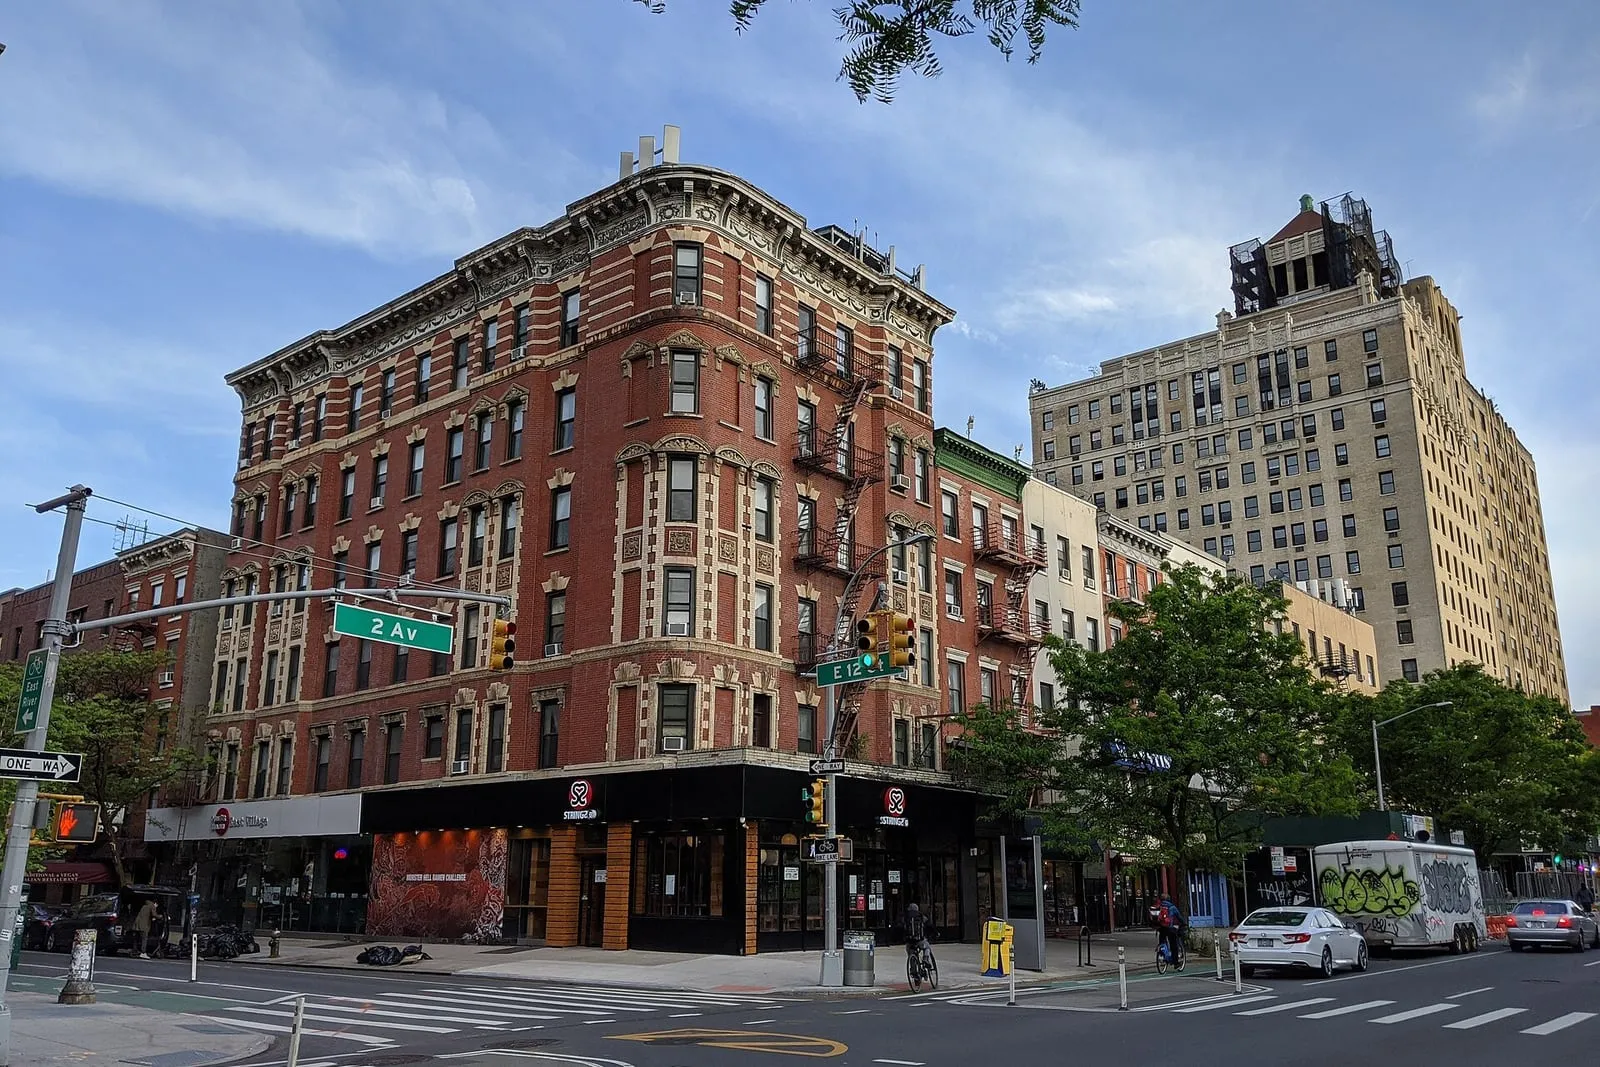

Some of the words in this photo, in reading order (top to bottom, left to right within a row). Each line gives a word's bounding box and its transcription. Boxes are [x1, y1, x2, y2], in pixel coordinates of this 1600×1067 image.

[371, 617, 384, 635] 2
[390, 622, 418, 641] Av
[833, 665, 843, 680] E
[846, 662, 862, 677] 12
[867, 659, 884, 673] t
[26, 680, 39, 692] East
[22, 697, 38, 708] River
[6, 757, 32, 770] ONE
[43, 760, 68, 773] WAY
